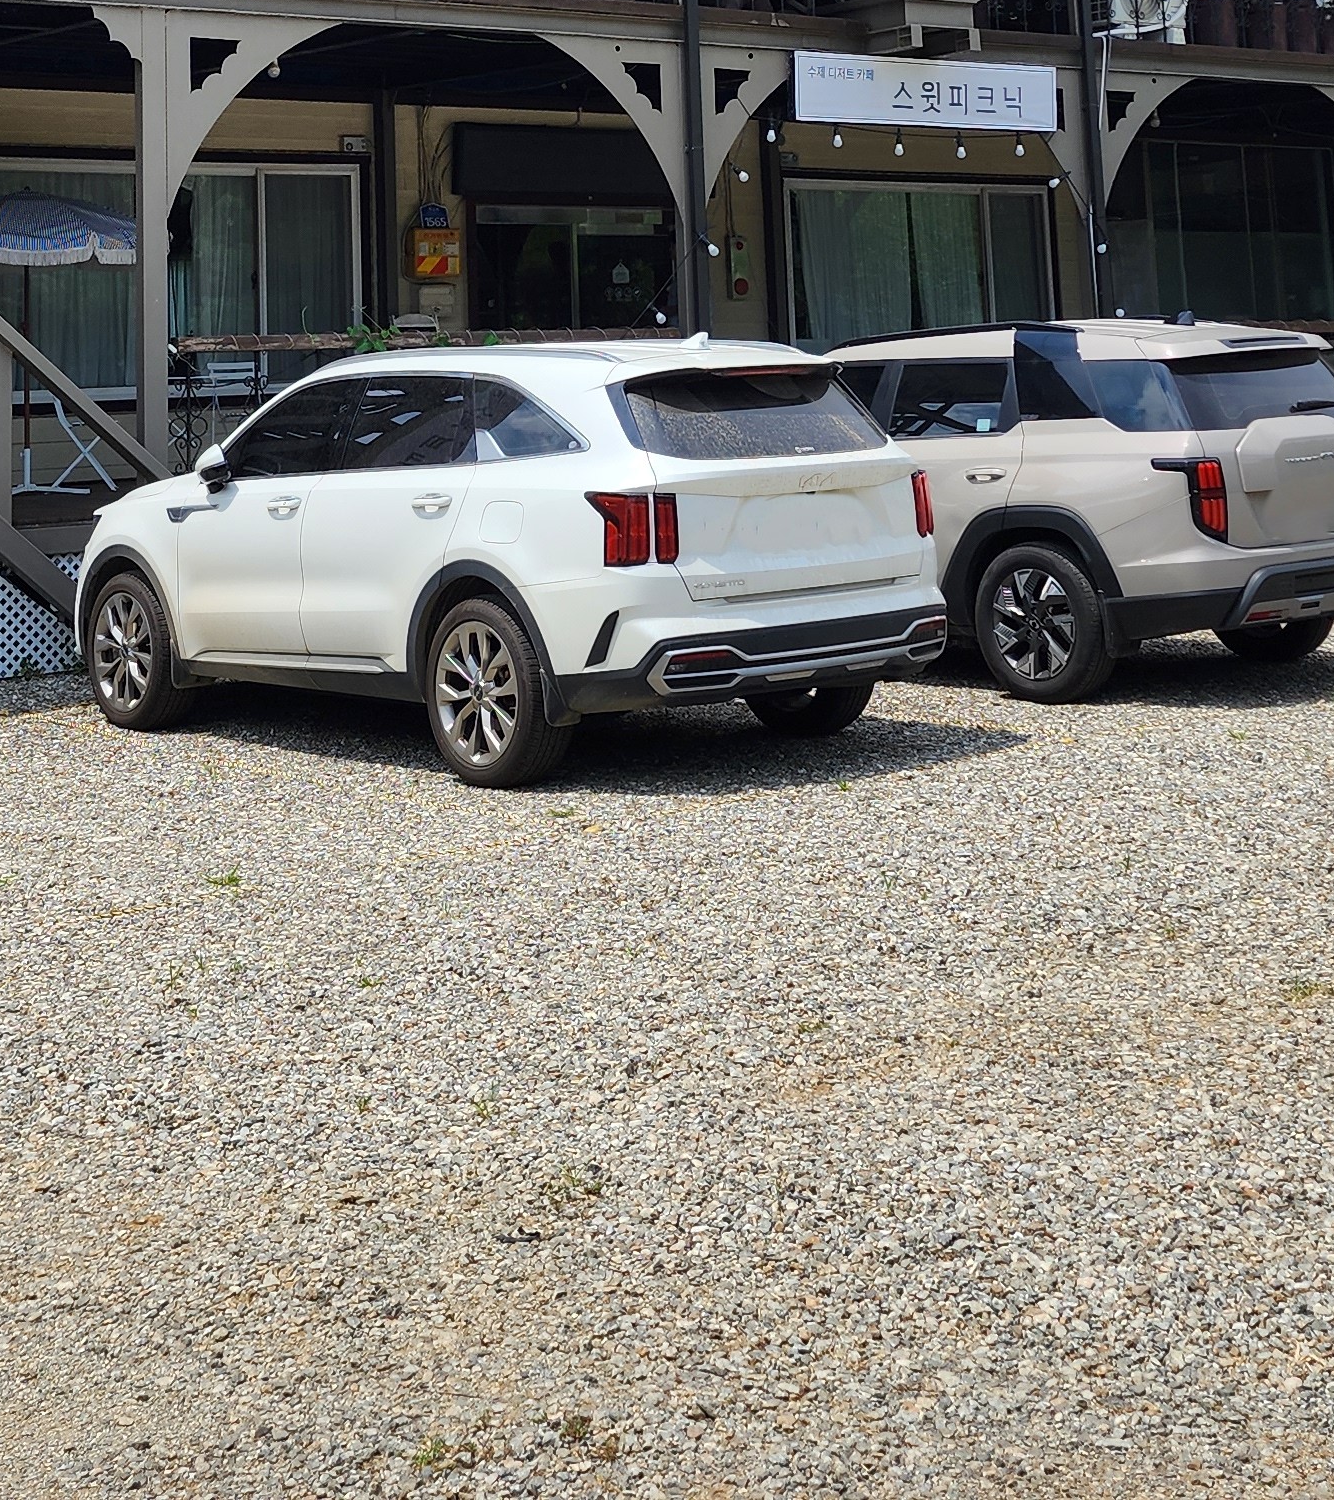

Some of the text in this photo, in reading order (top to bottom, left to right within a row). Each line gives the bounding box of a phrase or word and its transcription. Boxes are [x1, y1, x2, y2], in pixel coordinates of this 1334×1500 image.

[807, 65, 875, 81] 수제 디저트 카페
[891, 81, 1023, 119] 스윗피크닉
[424, 217, 447, 227] 1565
